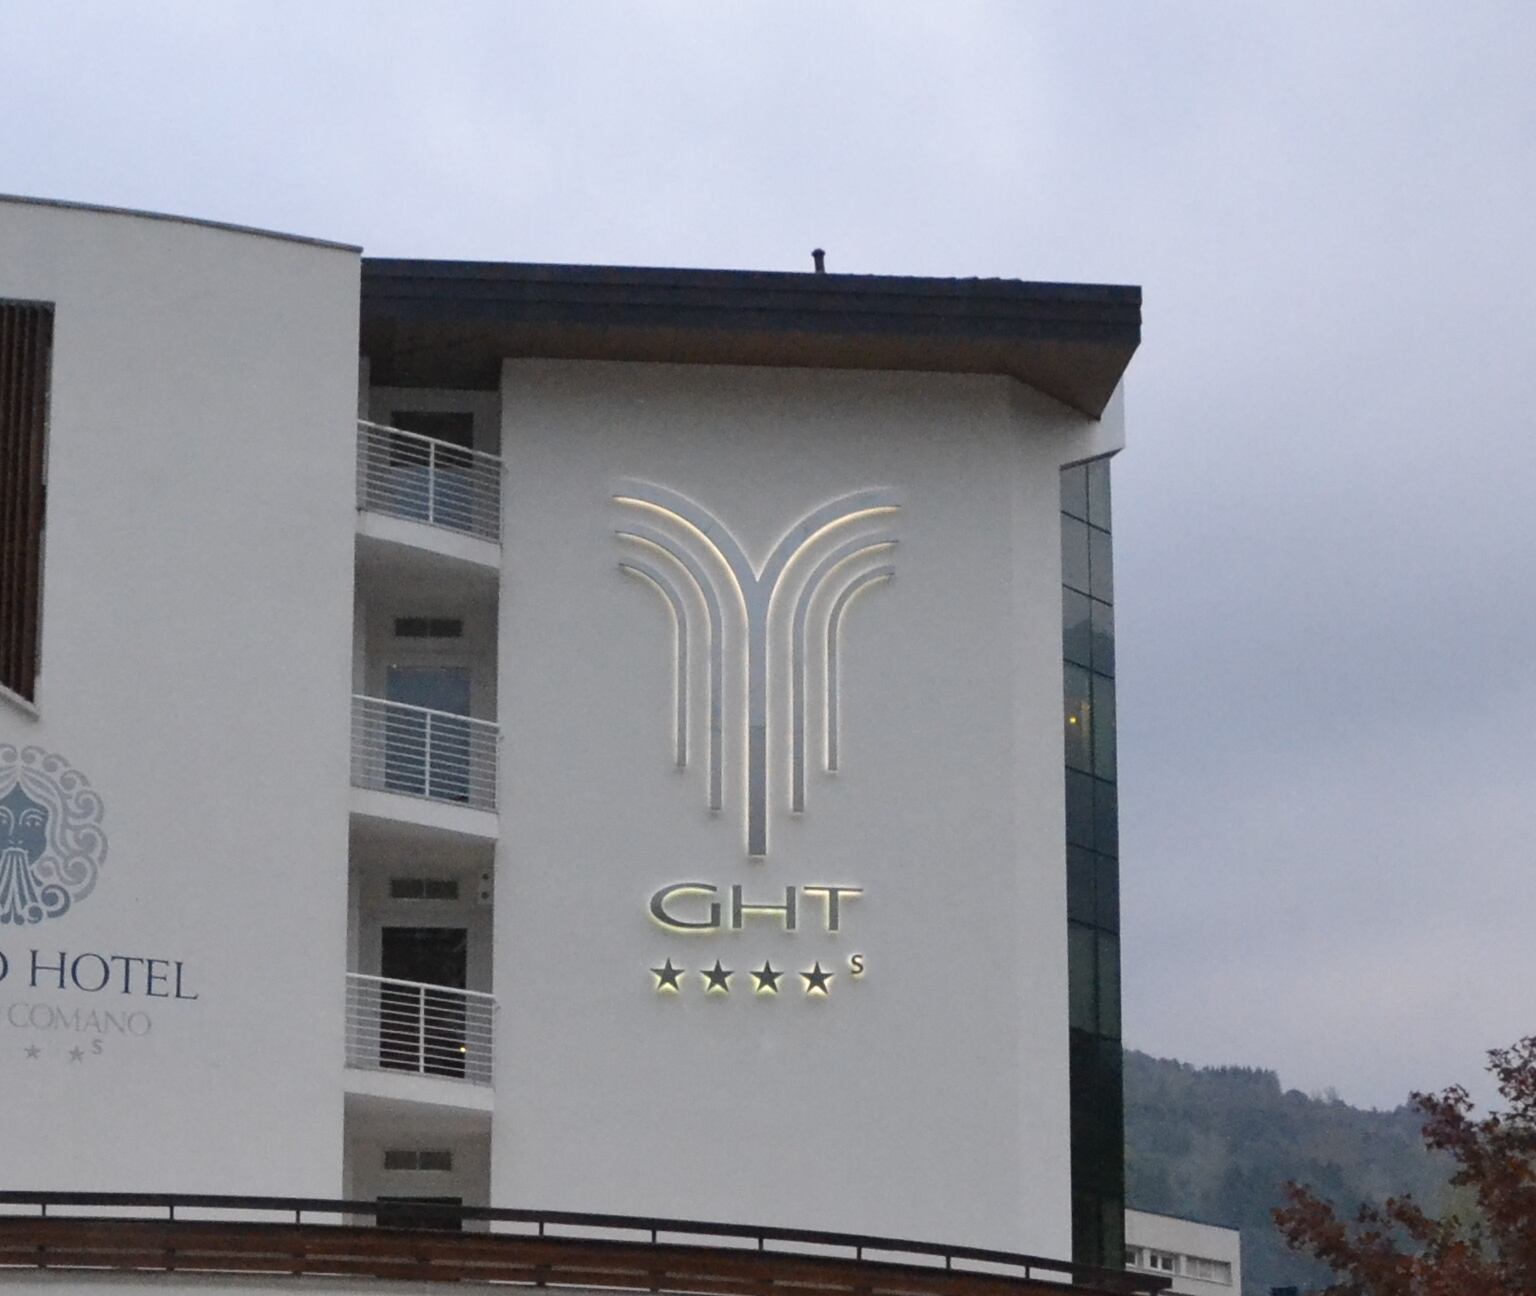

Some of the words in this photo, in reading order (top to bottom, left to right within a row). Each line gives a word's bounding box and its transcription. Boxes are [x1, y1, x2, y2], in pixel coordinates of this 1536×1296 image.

[649, 881, 864, 932] GHT
[29, 949, 199, 1001] HOTEL
[7, 1002, 153, 1036] COMANO
